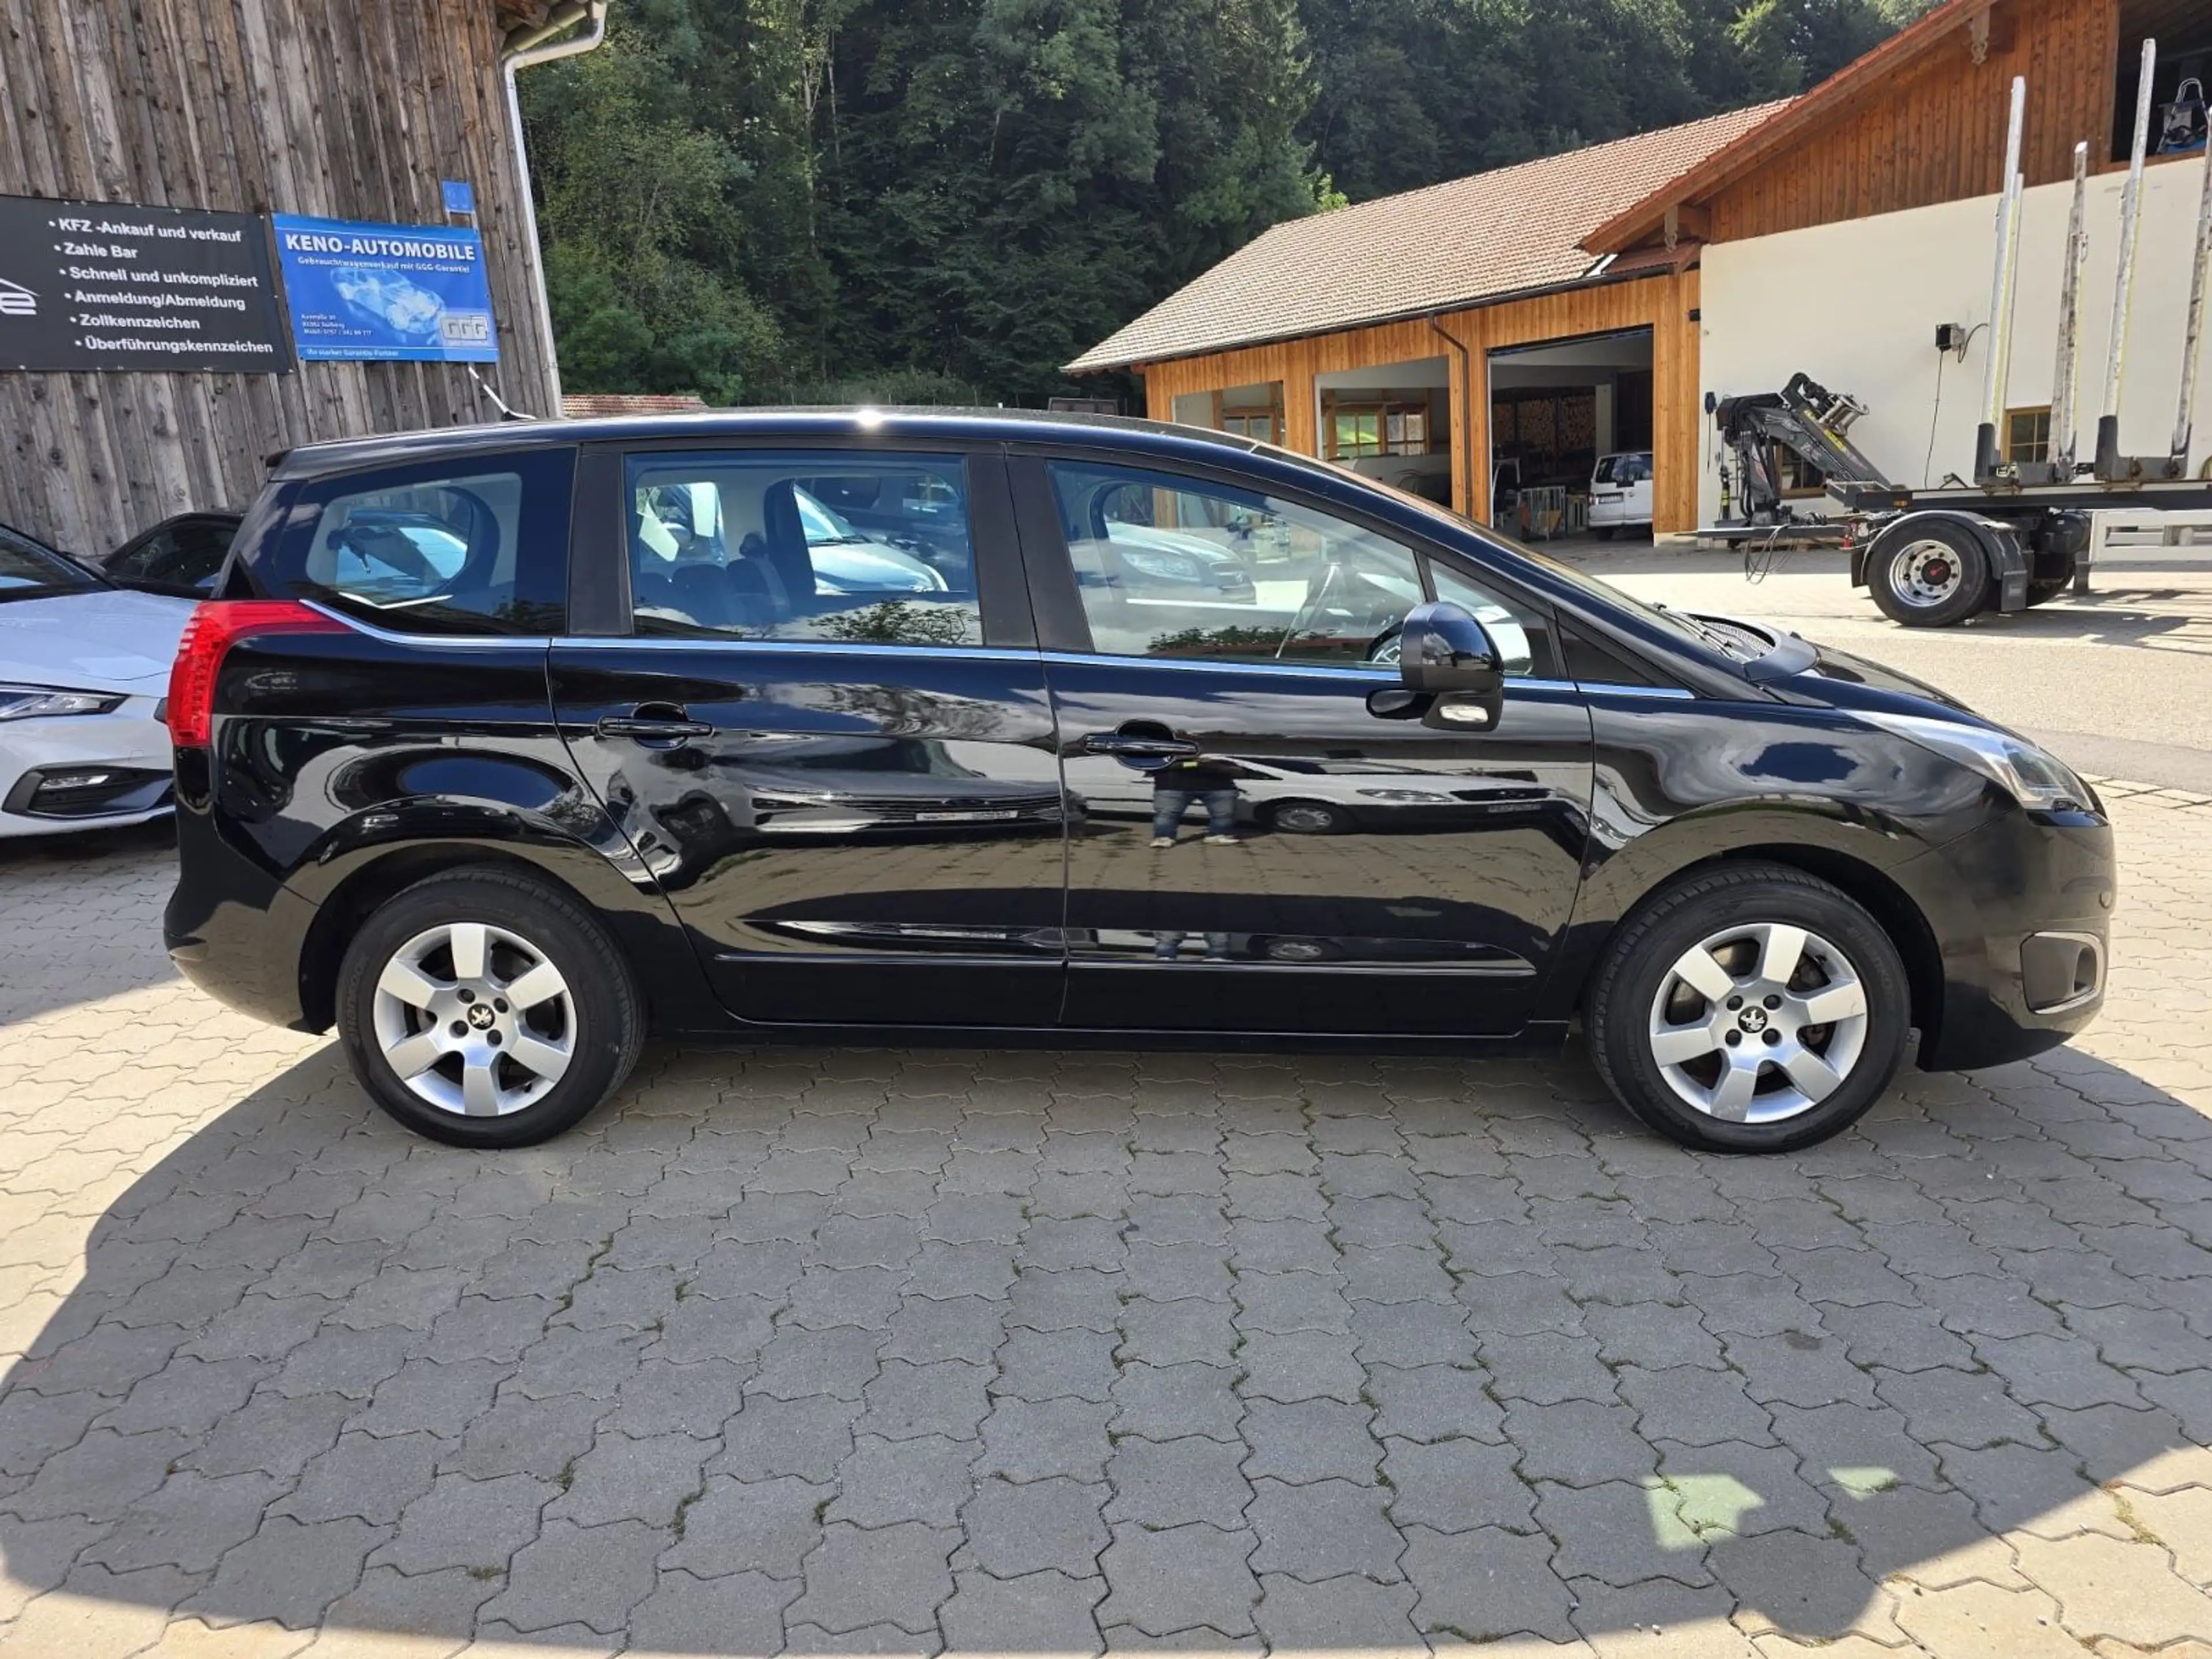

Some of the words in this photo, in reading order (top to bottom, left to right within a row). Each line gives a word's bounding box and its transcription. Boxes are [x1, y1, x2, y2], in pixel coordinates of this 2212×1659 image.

[58, 217, 93, 232] KFZ
[157, 226, 187, 238] und
[188, 228, 241, 243] verkauf
[63, 241, 108, 257] Zahle
[110, 244, 138, 259] Bar
[285, 233, 476, 261] KENO-AUTOMOBILE
[69, 266, 128, 281] Schnell
[130, 270, 160, 283] und
[162, 271, 259, 287] unkompliziert
[74, 289, 246, 311] Anmeldung/Abmeldung
[78, 313, 200, 329] Zollkennzeichen
[85, 334, 273, 354] Überführungskennzeichen
